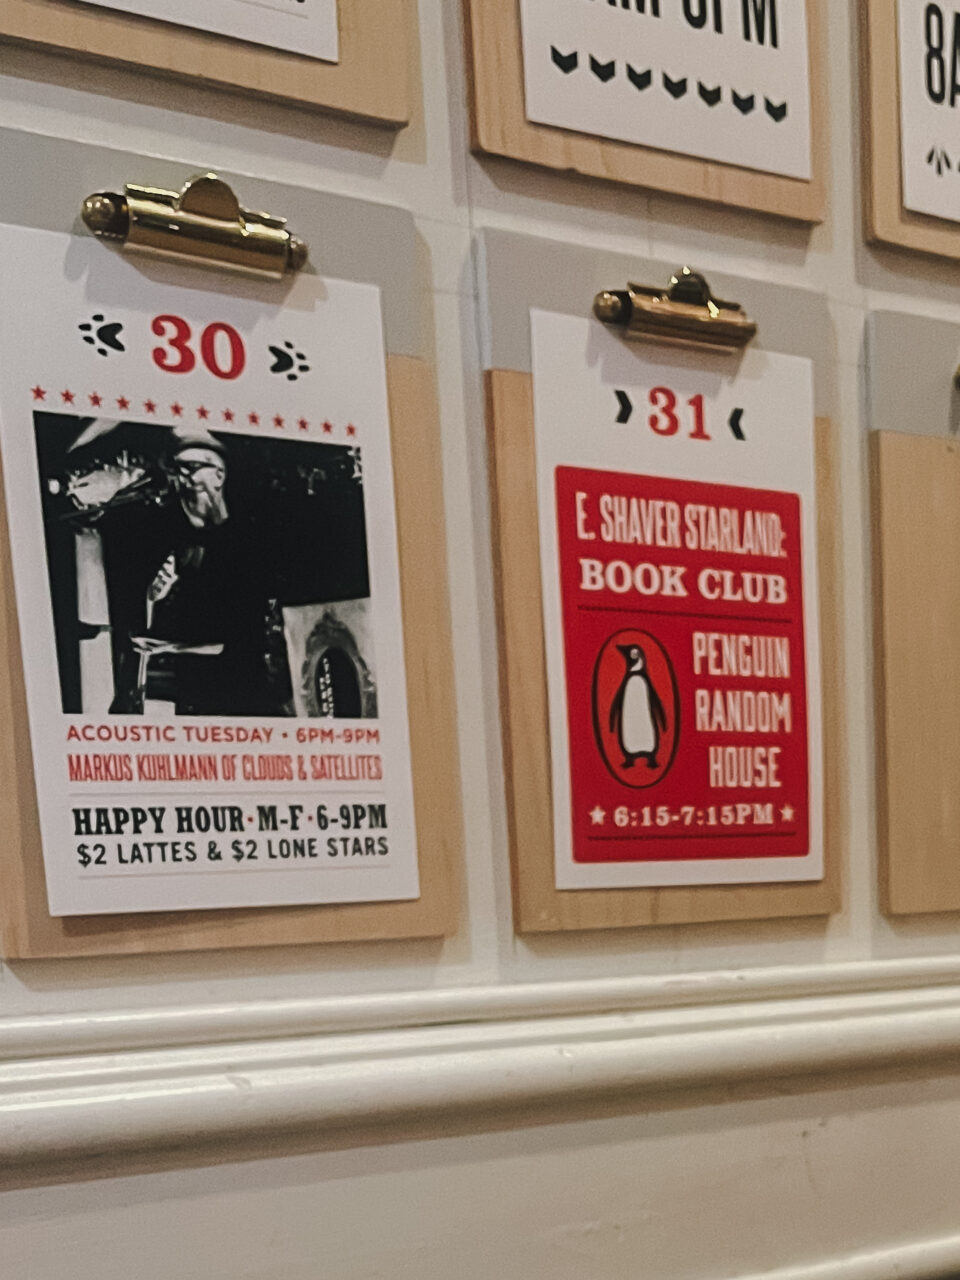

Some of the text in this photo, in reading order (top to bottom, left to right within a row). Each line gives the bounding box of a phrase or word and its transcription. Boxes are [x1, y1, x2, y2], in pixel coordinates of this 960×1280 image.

[151, 314, 246, 380] 30
[648, 386, 712, 441] 31
[600, 494, 681, 548] SHAVER
[579, 558, 788, 604] BOOK CLUB
[692, 631, 790, 678] PENGUIN
[694, 688, 792, 733] RANDOM
[67, 724, 380, 744] ACOUSTIC TUESDAY 6PM-9PM
[67, 754, 383, 782] MARKUS KUHLMANN OF CLOUDS & SATELLITES
[708, 746, 782, 788] HOUSE
[72, 806, 166, 836] HAPPY
[175, 805, 245, 834] HOUR
[613, 803, 774, 827] 6:15-7:15PM
[77, 836, 389, 868] $2 LATTES & $2 LONE STARS
